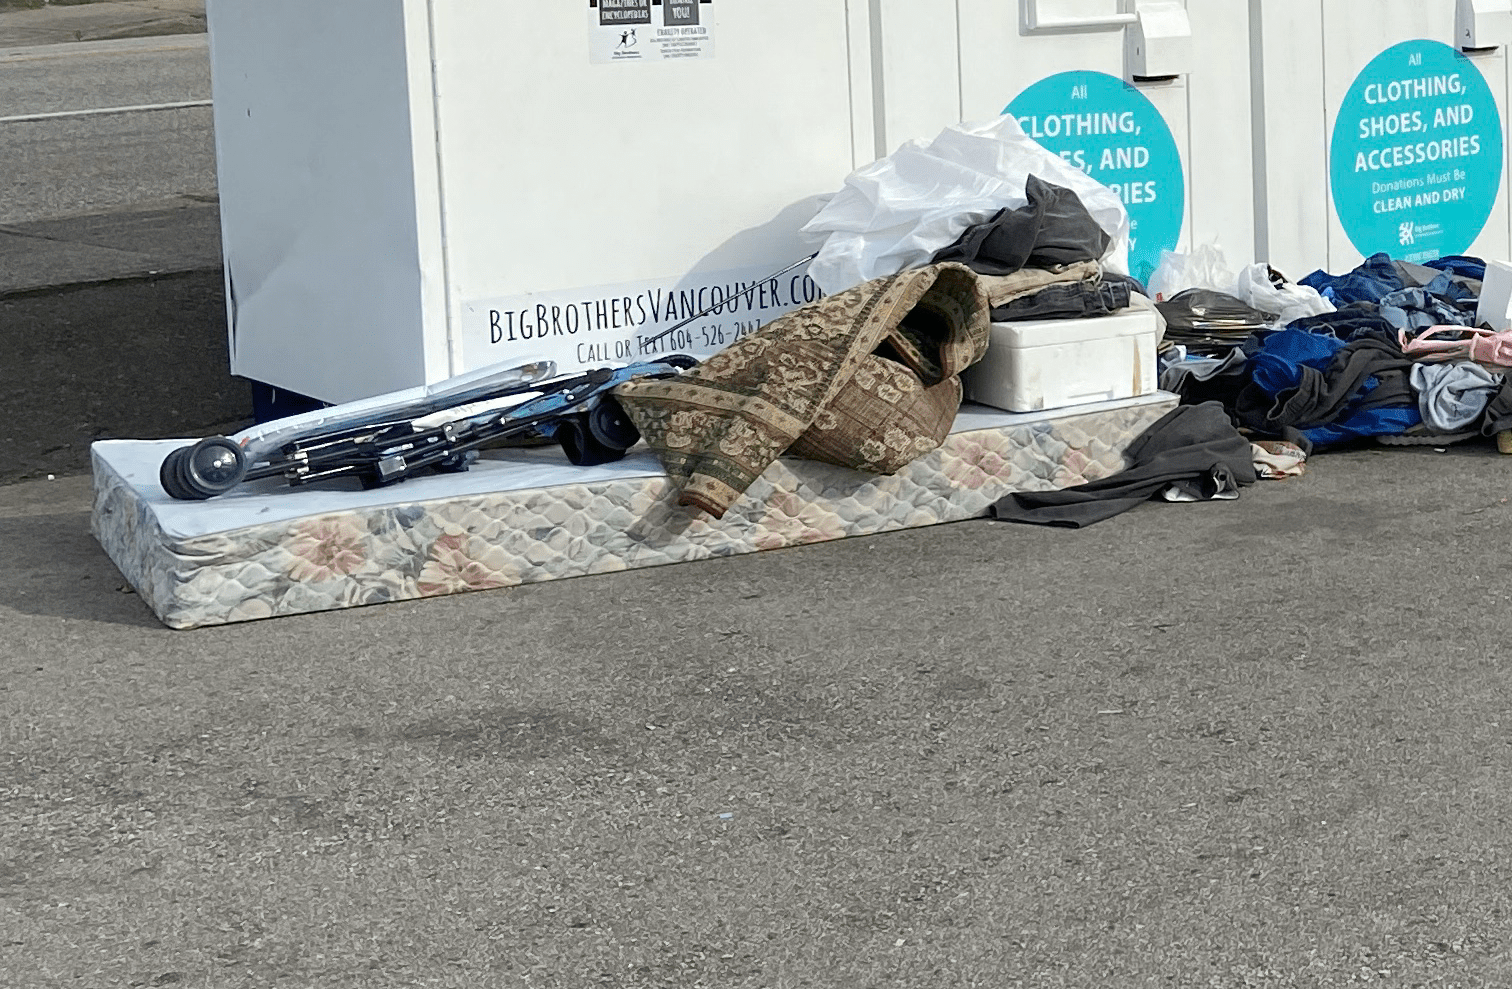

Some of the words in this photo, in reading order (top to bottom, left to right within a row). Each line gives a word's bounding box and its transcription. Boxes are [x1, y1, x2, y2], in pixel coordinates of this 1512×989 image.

[1408, 52, 1422, 66] All
[1071, 84, 1088, 100] All
[1364, 73, 1467, 105] CLOTHING,
[1017, 111, 1141, 139] CLOTHING,
[1359, 111, 1428, 139] SHOES,
[1433, 104, 1474, 129] AND
[1099, 146, 1150, 170] AND
[1354, 134, 1481, 172] ACCESSORIES
[1372, 174, 1425, 195] Donations
[1426, 171, 1451, 185] Must
[1453, 168, 1466, 181] Be
[1373, 195, 1412, 214] CLEAN
[1415, 191, 1440, 207] AND
[1442, 186, 1466, 202] DRY
[577, 342, 611, 364] CALL
[615, 340, 631, 359] OR
[636, 334, 667, 355] TEXT
